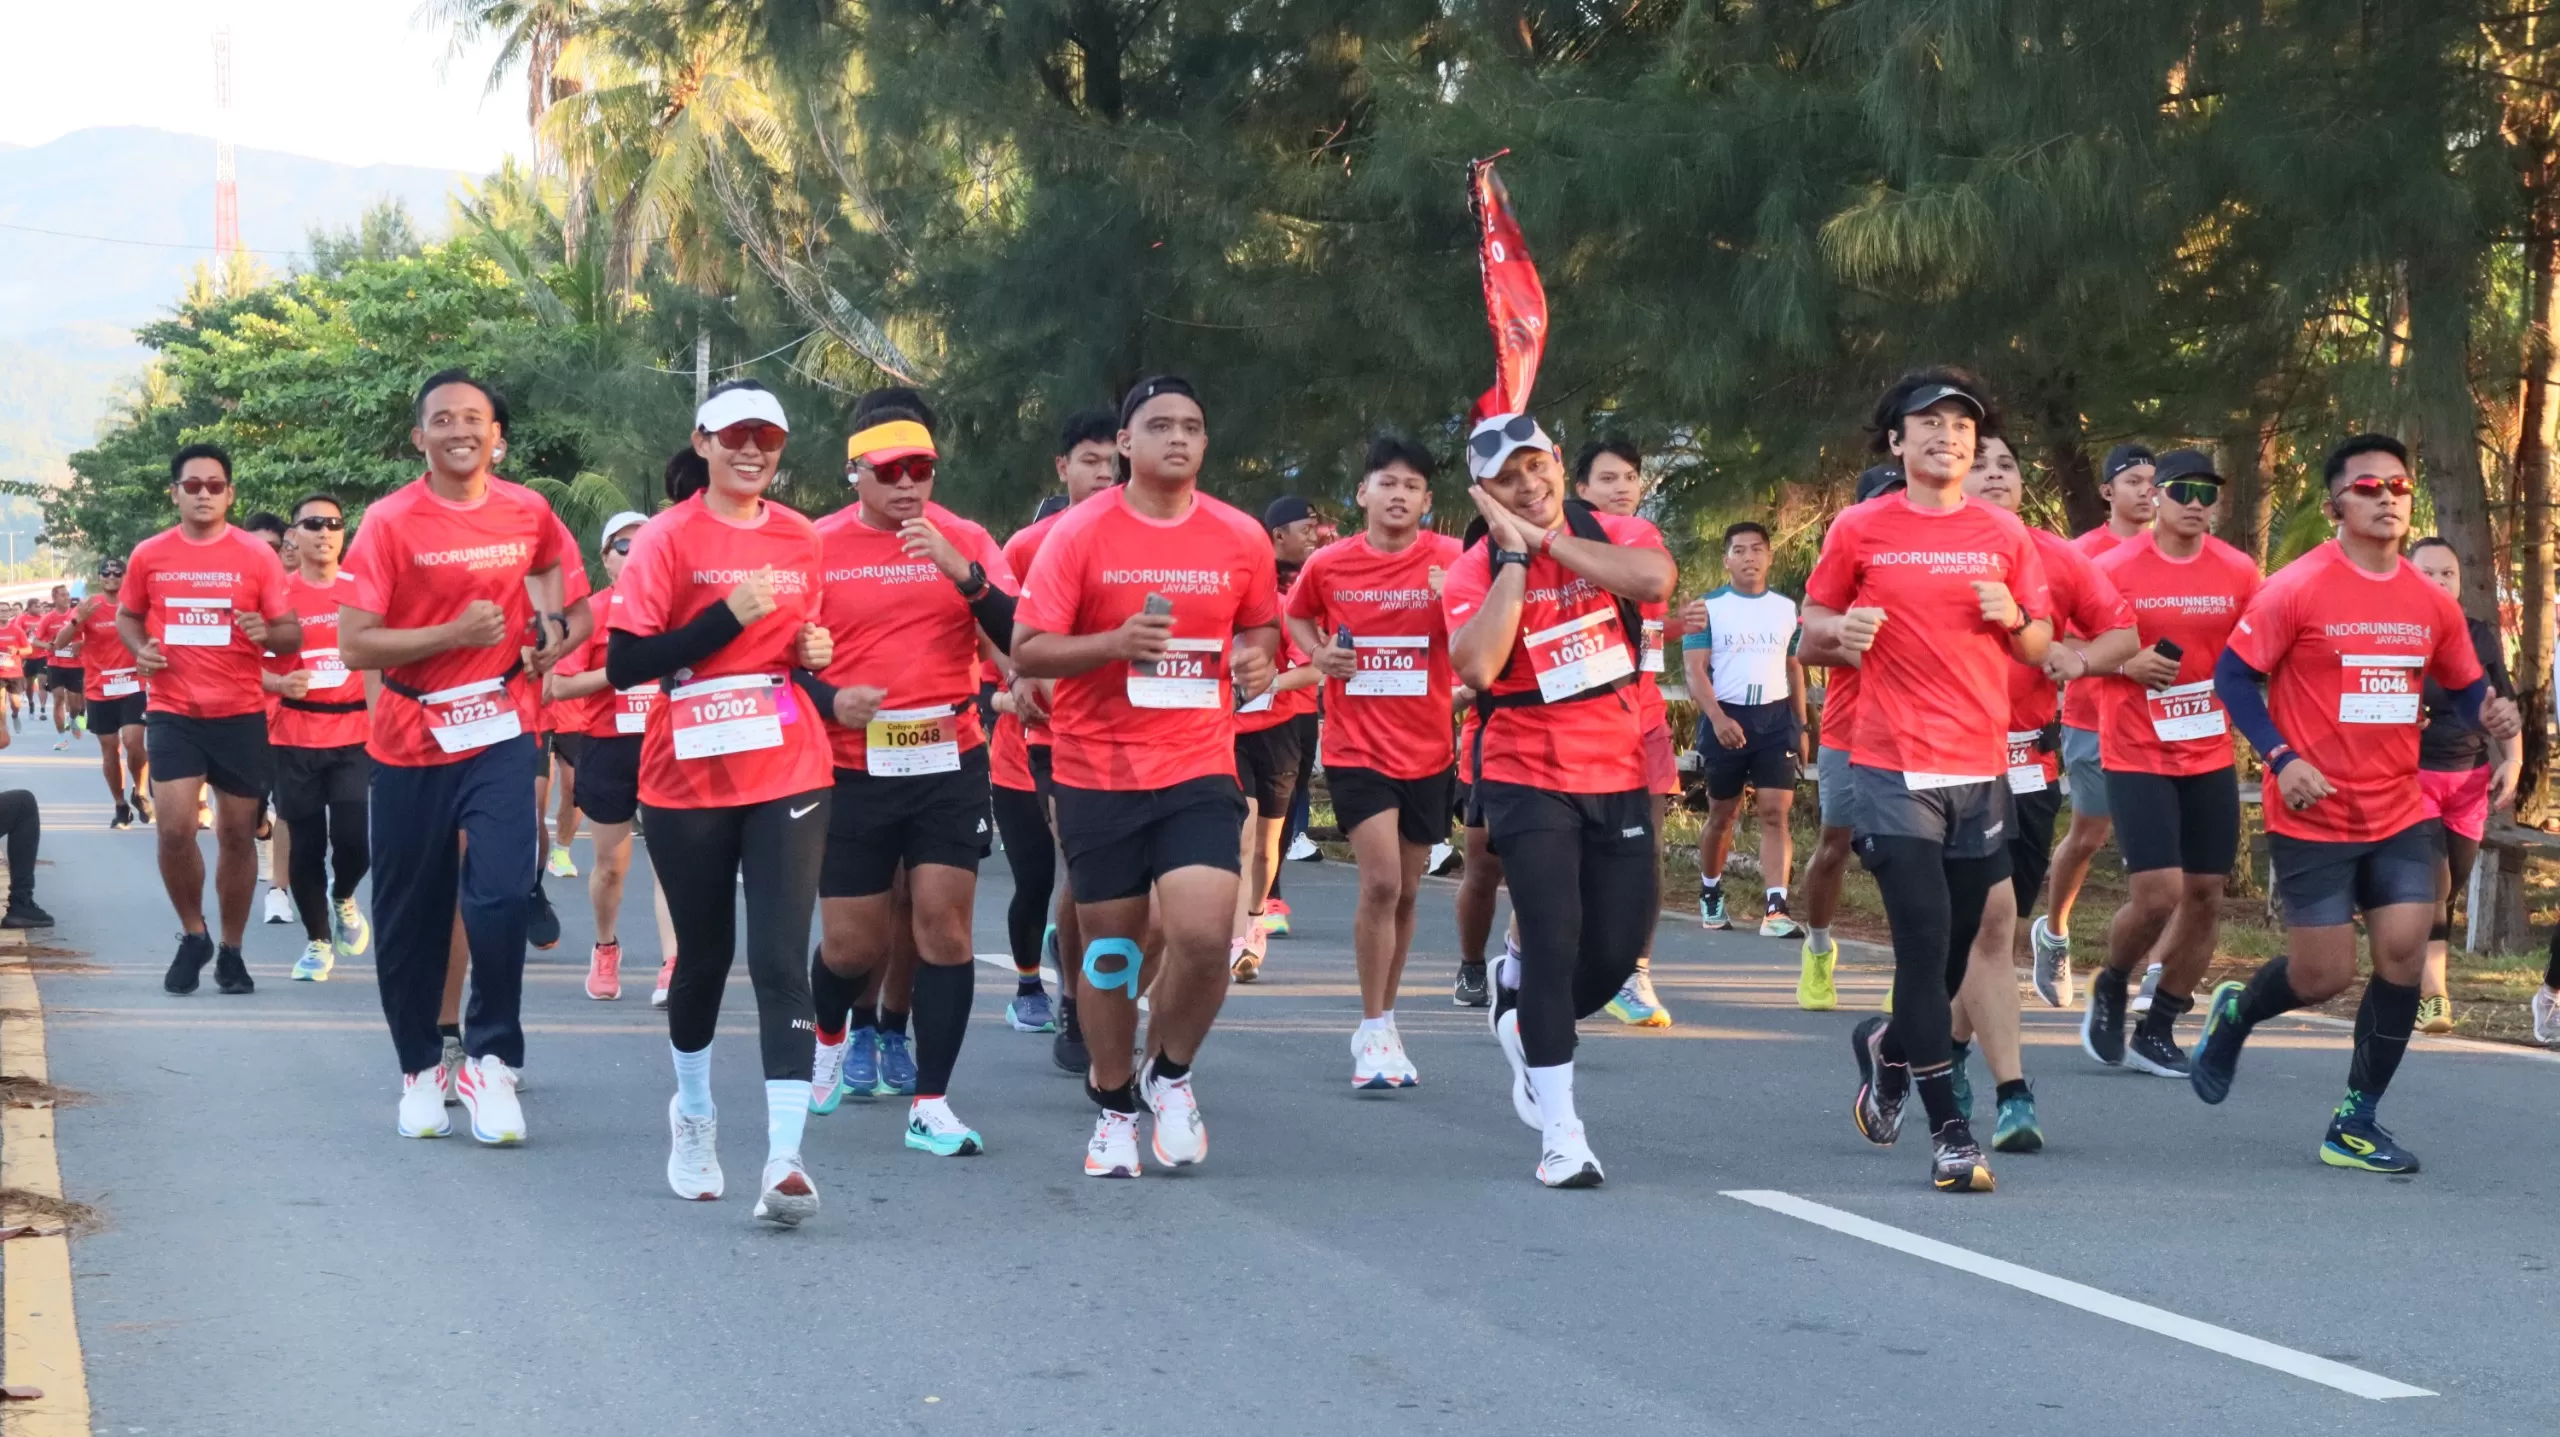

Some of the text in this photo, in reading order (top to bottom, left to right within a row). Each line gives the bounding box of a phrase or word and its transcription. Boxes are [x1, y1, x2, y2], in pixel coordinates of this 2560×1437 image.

[413, 543, 518, 566] INDORUNNERS
[1873, 552, 1988, 565] INDORUNNERS
[467, 556, 518, 571] JAYAPURA
[1929, 564, 1988, 574] JAYAPURA
[155, 572, 233, 582] INDORUNNERS
[881, 573, 939, 585] JAYAPURA
[1102, 569, 1220, 585] INDORUNNERS
[1160, 583, 1220, 595] JAYAPURA
[1333, 588, 1429, 603] INDORUNNERS
[1379, 600, 1429, 610] JAYAPURA
[2135, 595, 2227, 609] INDORUNNERS
[2181, 605, 2227, 616] JAYAPURA
[178, 612, 219, 625] 10193
[2325, 622, 2423, 637] INDORUNNERS
[2375, 635, 2423, 646] JAYAPURA
[1549, 633, 1605, 667] 10037
[1155, 660, 1203, 677] 0124
[1362, 655, 1414, 670] 10140
[2359, 677, 2409, 694] 10046
[441, 700, 499, 727] 10225
[627, 700, 650, 713] 101
[691, 696, 758, 723] 10202
[2164, 699, 2211, 719] 10178
[885, 728, 941, 747] 10048
[791, 1018, 817, 1032] NIKE
